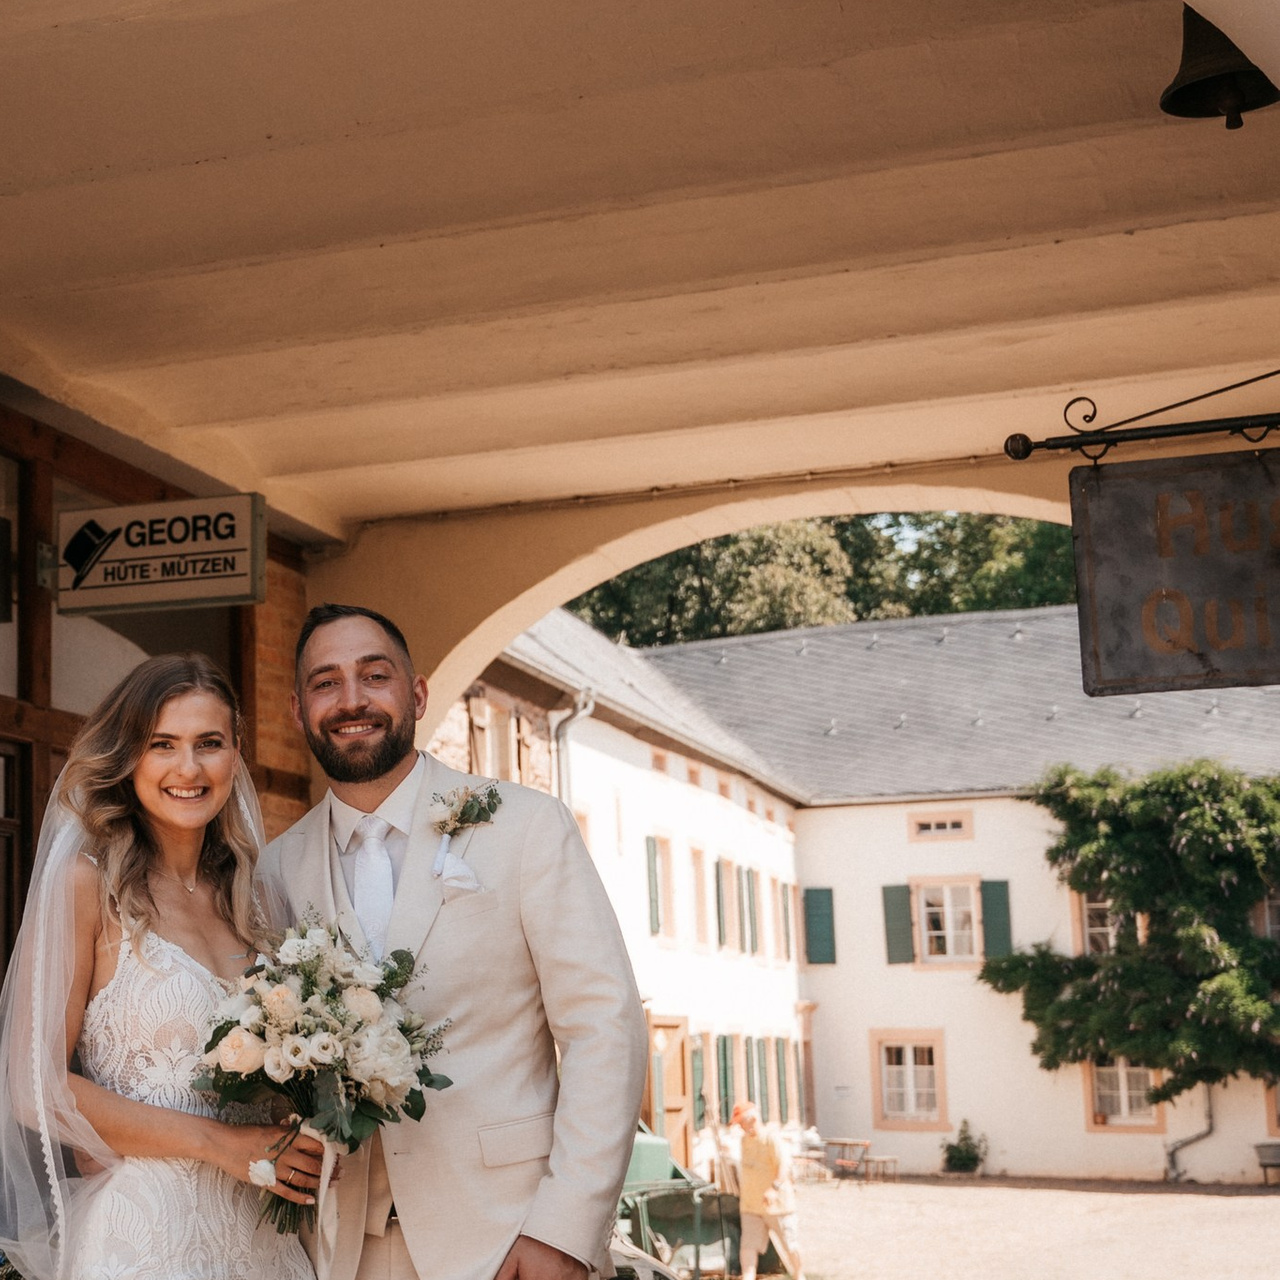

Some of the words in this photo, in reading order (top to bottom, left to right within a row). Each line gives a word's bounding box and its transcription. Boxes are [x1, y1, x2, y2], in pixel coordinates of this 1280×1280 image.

[124, 512, 236, 548] GEORG
[1156, 489, 1280, 558] Hu
[103, 558, 151, 583] HÜTE
[161, 554, 236, 578] MÜTZEN
